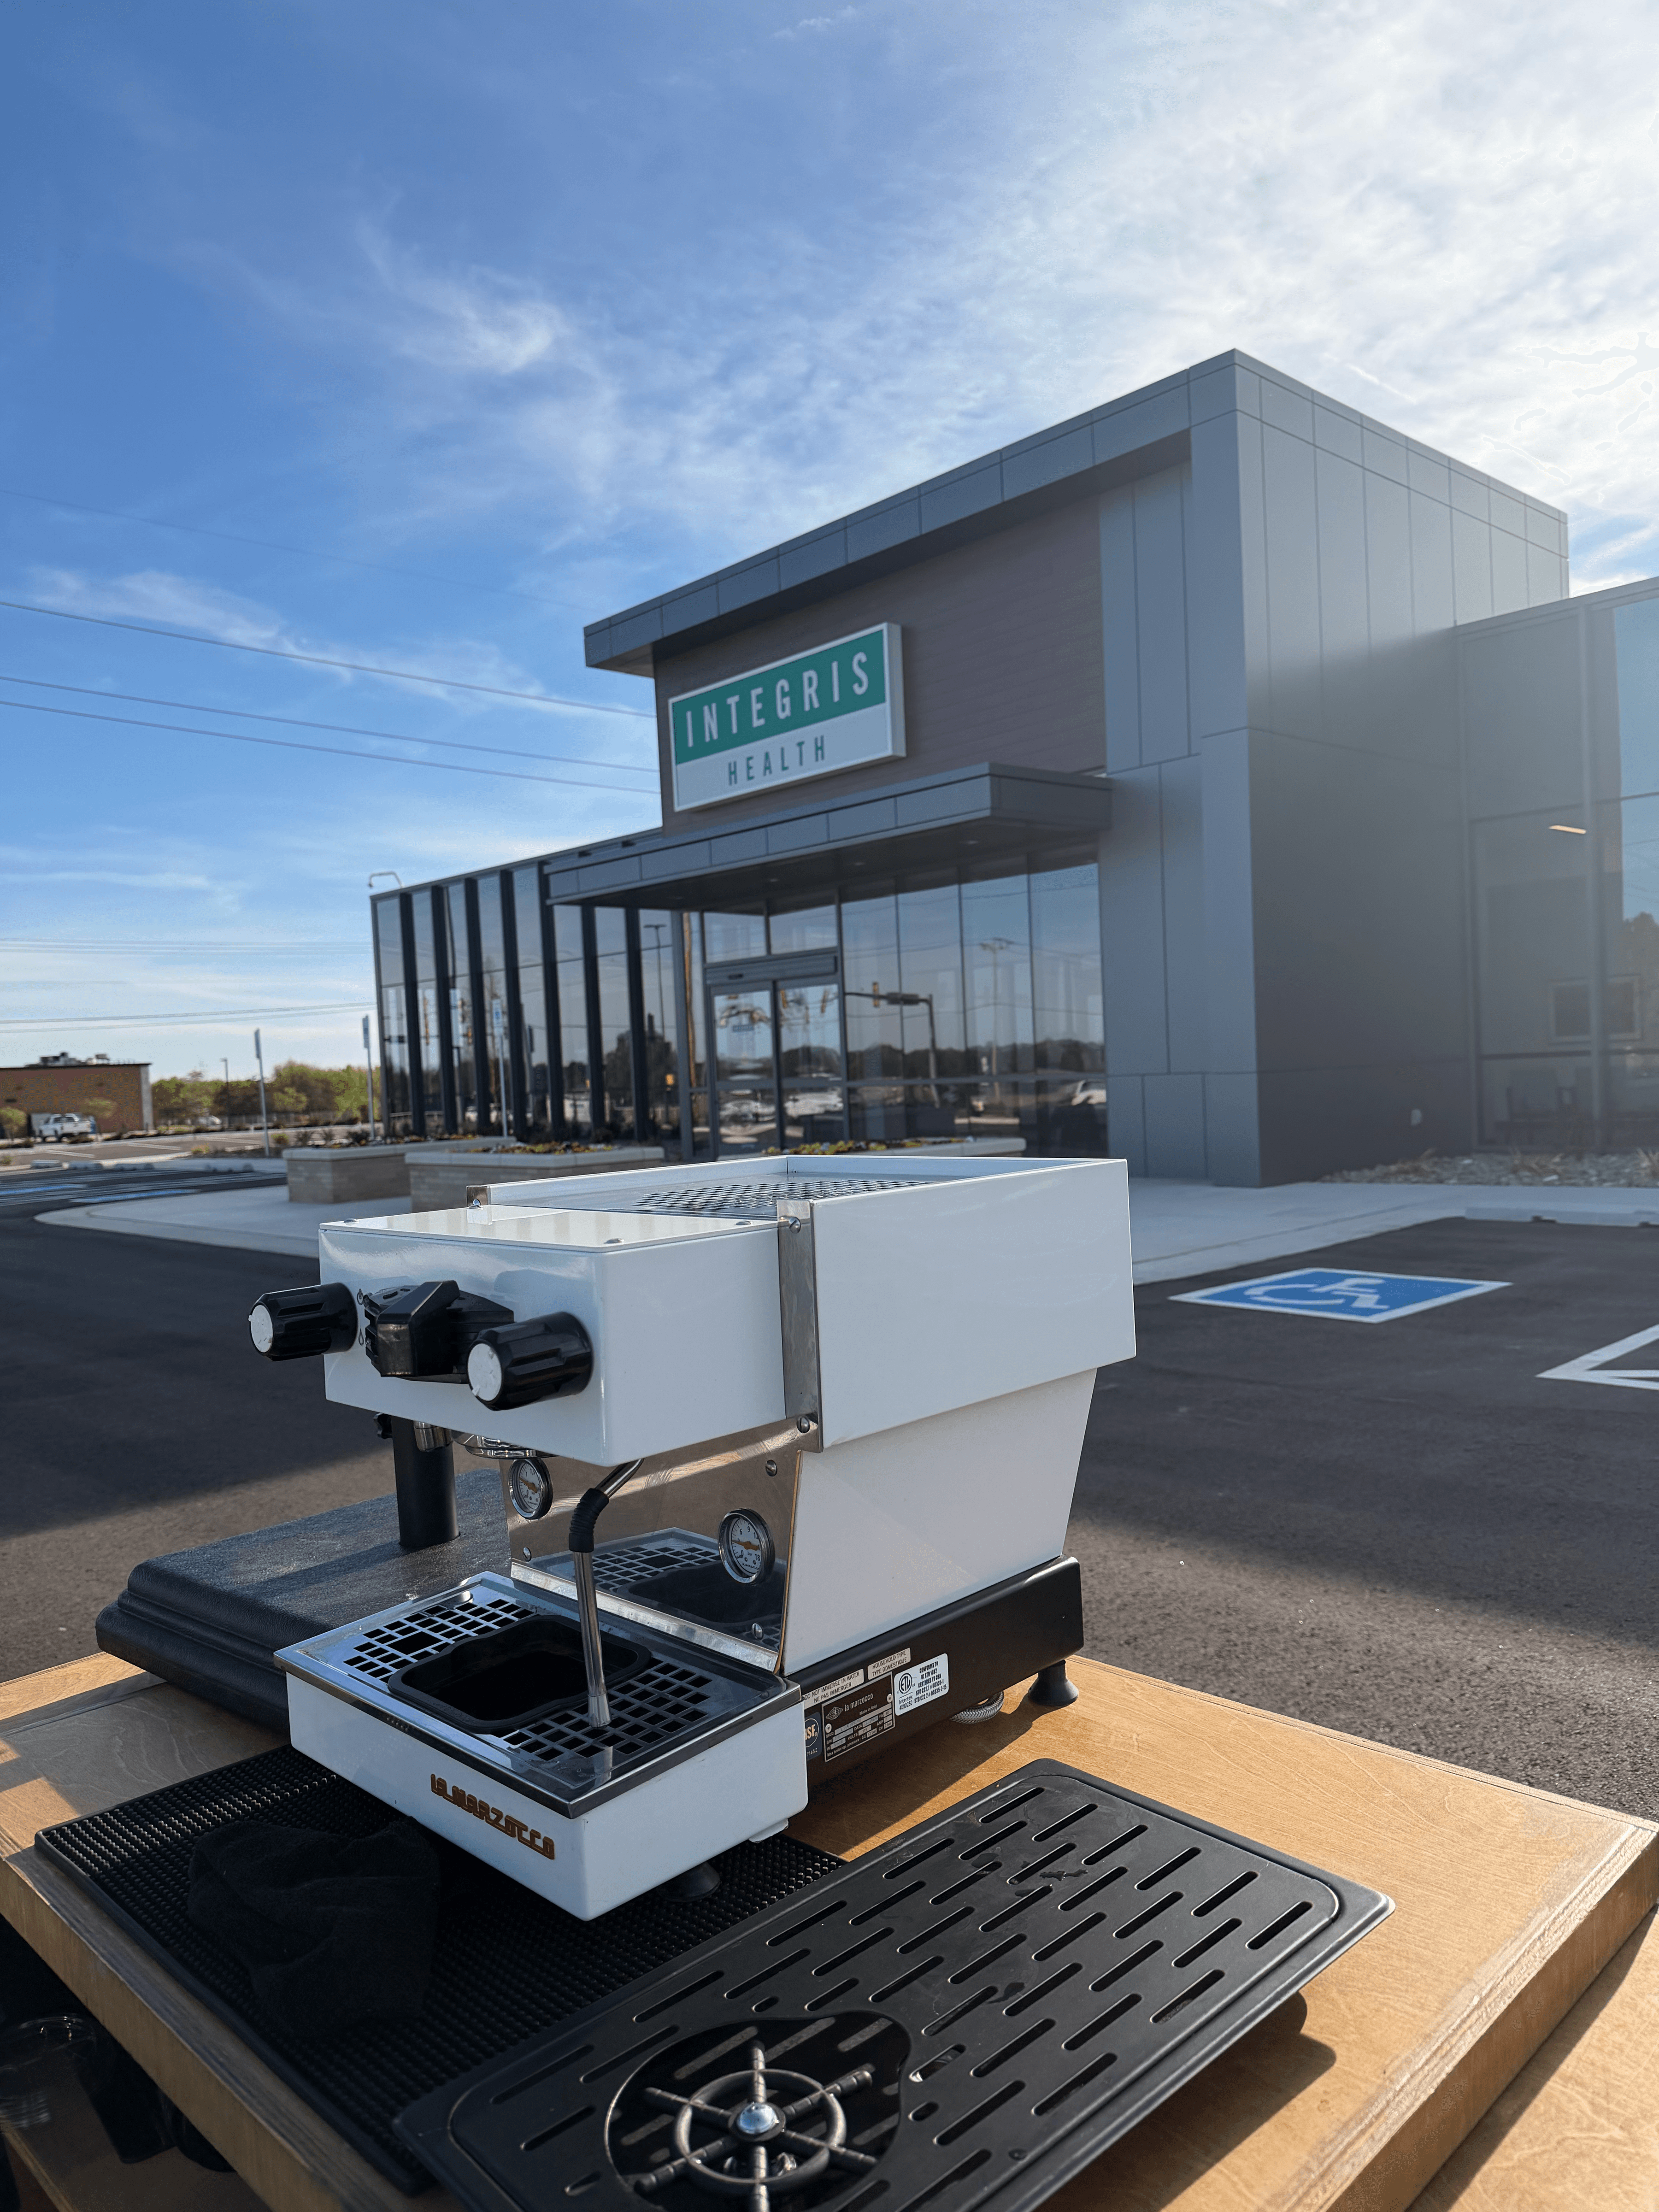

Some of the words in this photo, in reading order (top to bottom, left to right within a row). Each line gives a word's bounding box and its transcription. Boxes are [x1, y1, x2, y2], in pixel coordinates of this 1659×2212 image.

[686, 652, 868, 747] INTEGRIS
[729, 735, 824, 786] HEALTH
[872, 1655, 896, 1670] HOUSEHOLD
[872, 1668, 881, 1677] TYPE
[882, 1657, 906, 1672] DOMESTIQUE
[821, 1680, 840, 1693] IMMERSE
[847, 1671, 859, 1680] WATER
[830, 1682, 851, 1695] IMMERGER
[901, 1676, 911, 1691] ETL
[850, 1693, 873, 1709] marzocco
[899, 1694, 913, 1705] Intertek
